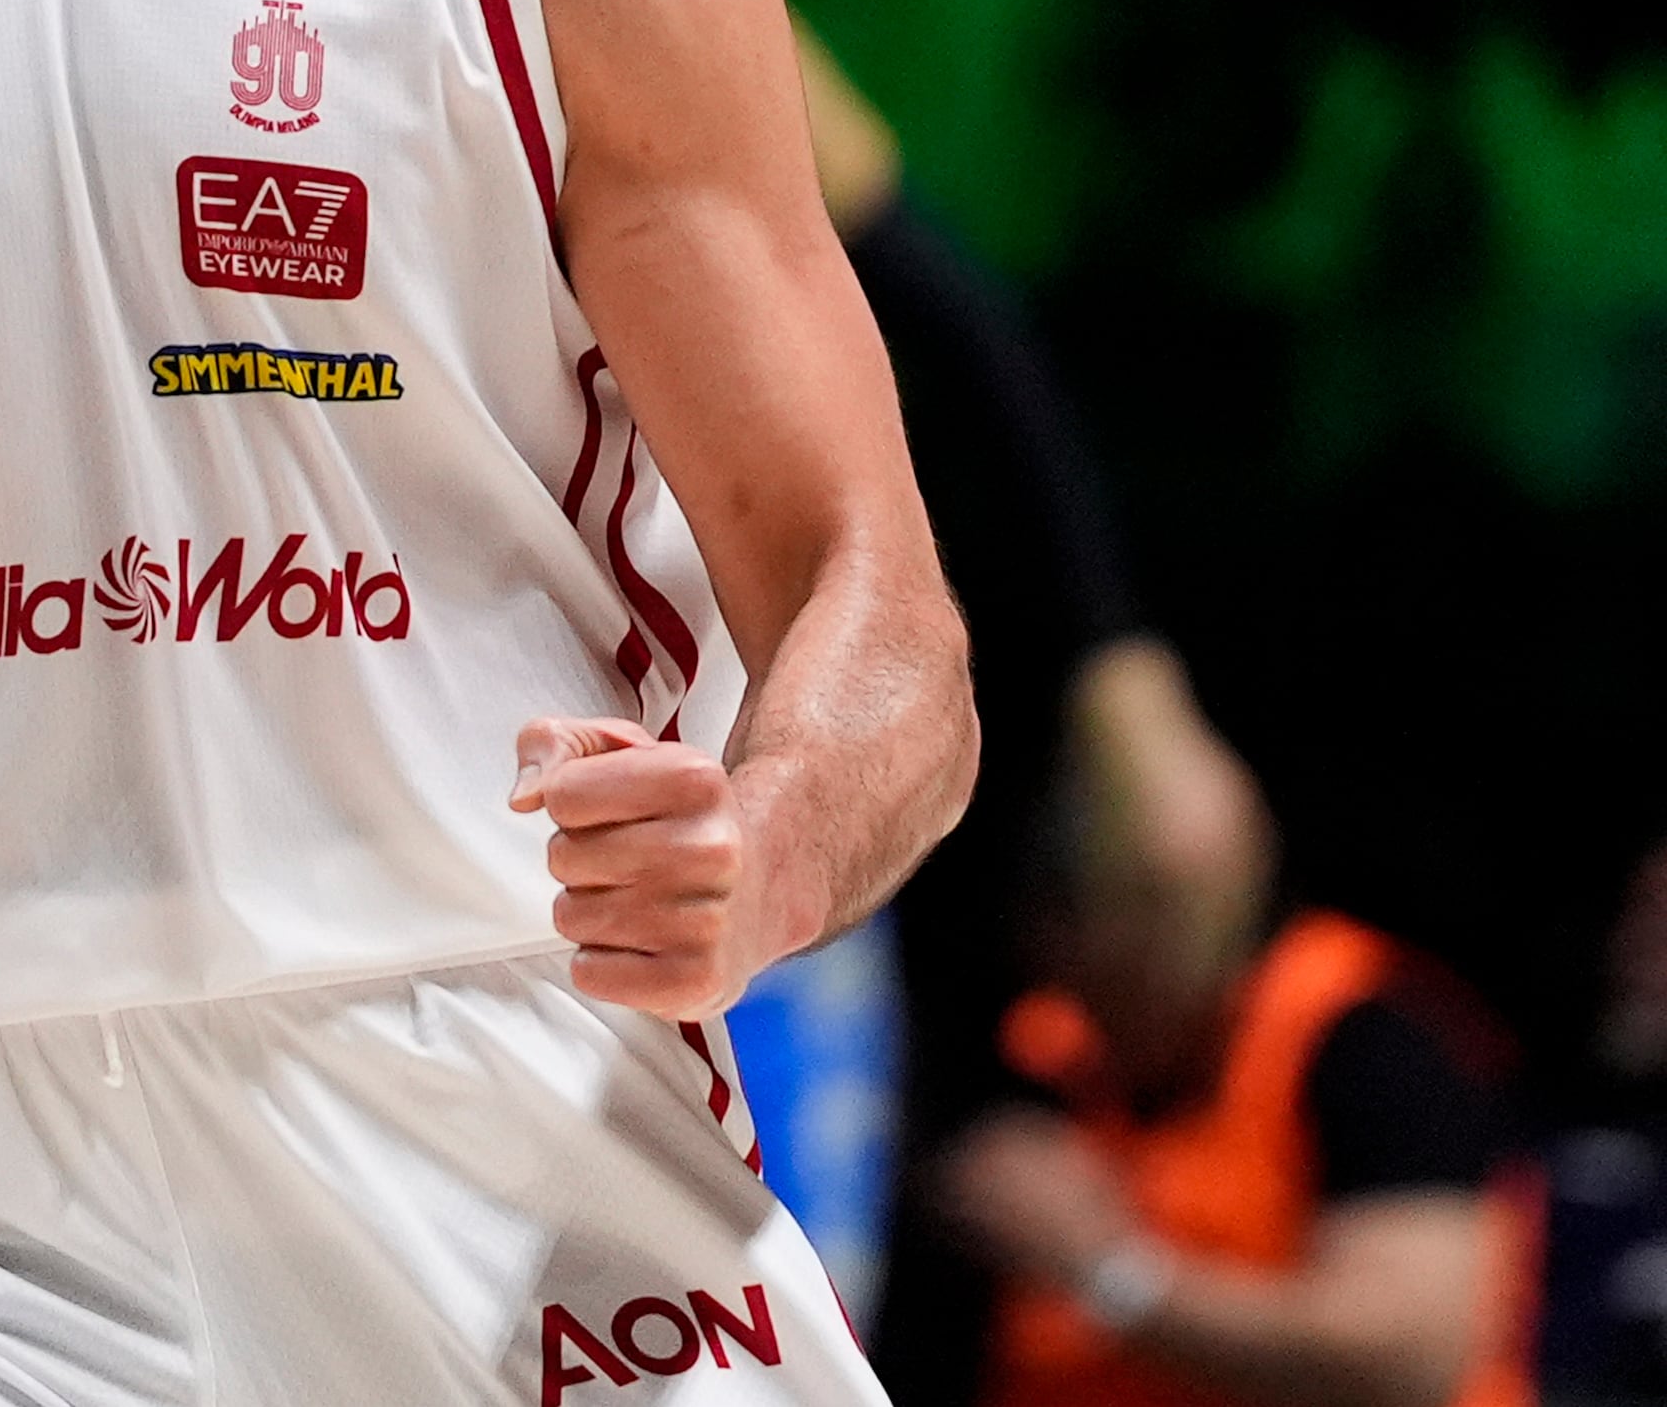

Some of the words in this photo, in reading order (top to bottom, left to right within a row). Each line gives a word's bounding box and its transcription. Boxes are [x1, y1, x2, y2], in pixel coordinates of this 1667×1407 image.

[193, 171, 351, 240] EA7
[198, 231, 266, 254] EMPORIO
[285, 242, 350, 264] ARMANI
[199, 251, 346, 286] EYEWEAR
[150, 346, 402, 401] SIMMENTHAL
[541, 1284, 782, 1407] AON
